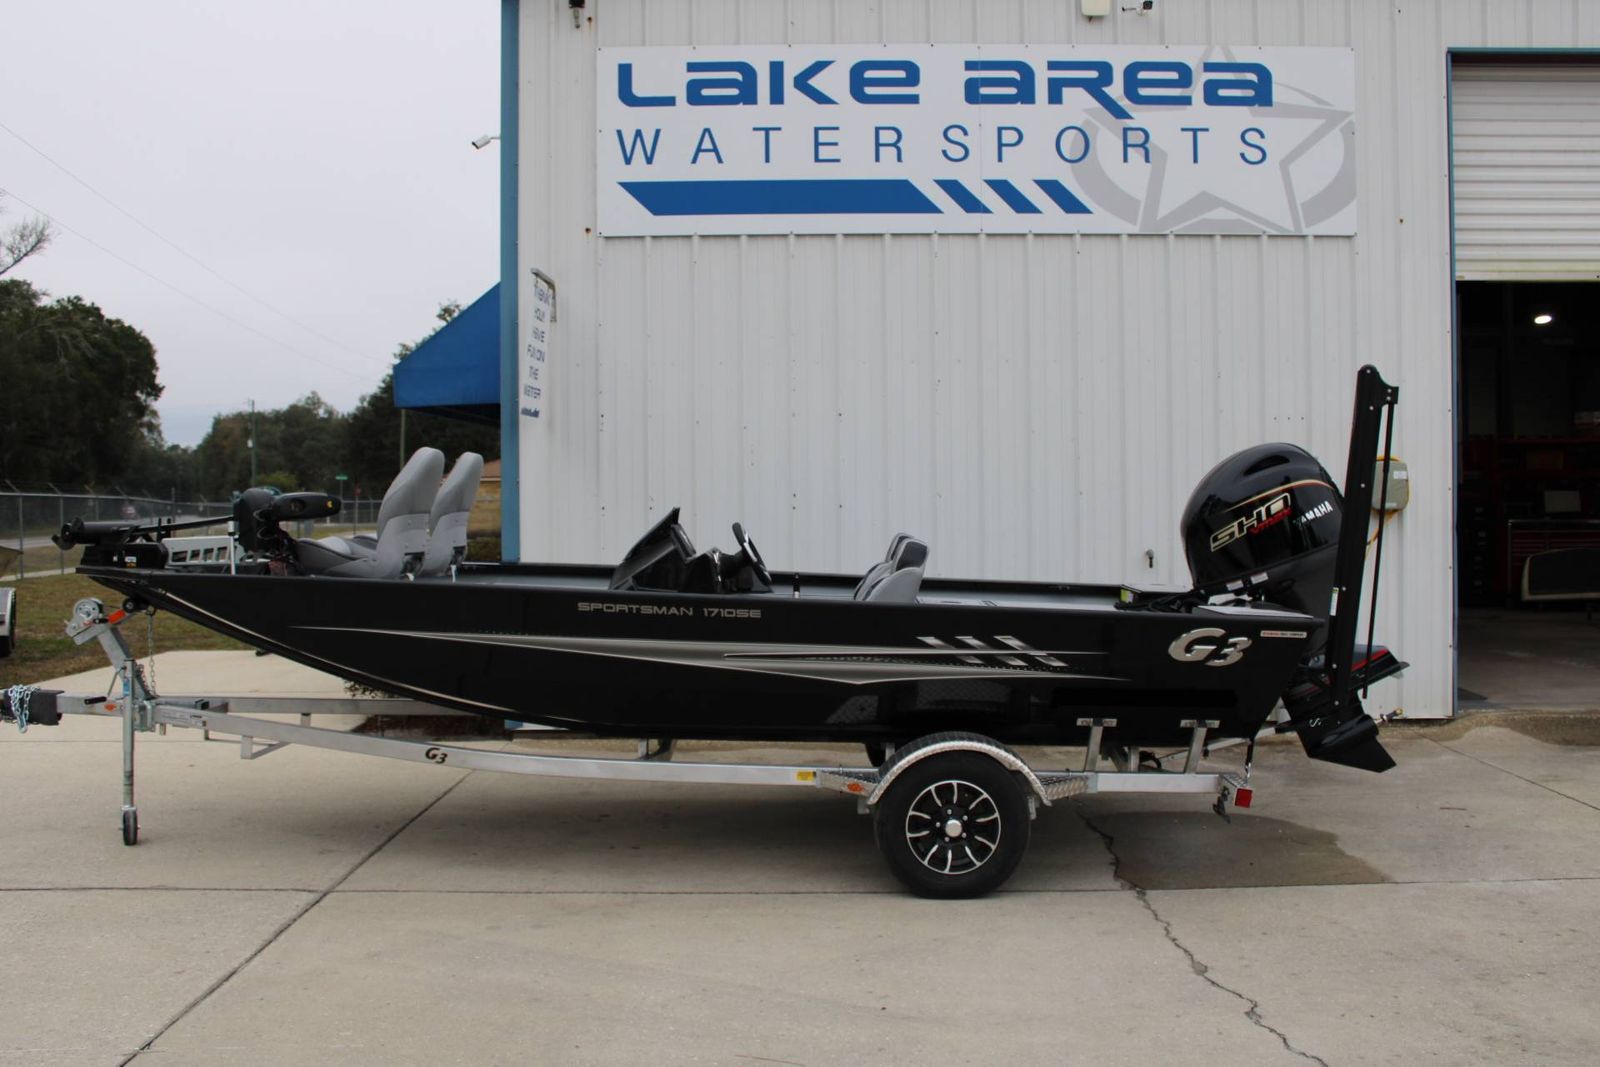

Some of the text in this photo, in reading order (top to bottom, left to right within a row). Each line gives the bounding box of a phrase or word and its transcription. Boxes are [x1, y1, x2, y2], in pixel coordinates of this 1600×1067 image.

[615, 124, 1268, 165] WATERSPORTS
[1209, 492, 1292, 552] SHO
[1296, 500, 1334, 525] AMAHA
[577, 602, 762, 618] SPORTSMAN 1710SE
[1168, 627, 1253, 667] G3
[425, 747, 448, 764] G3
